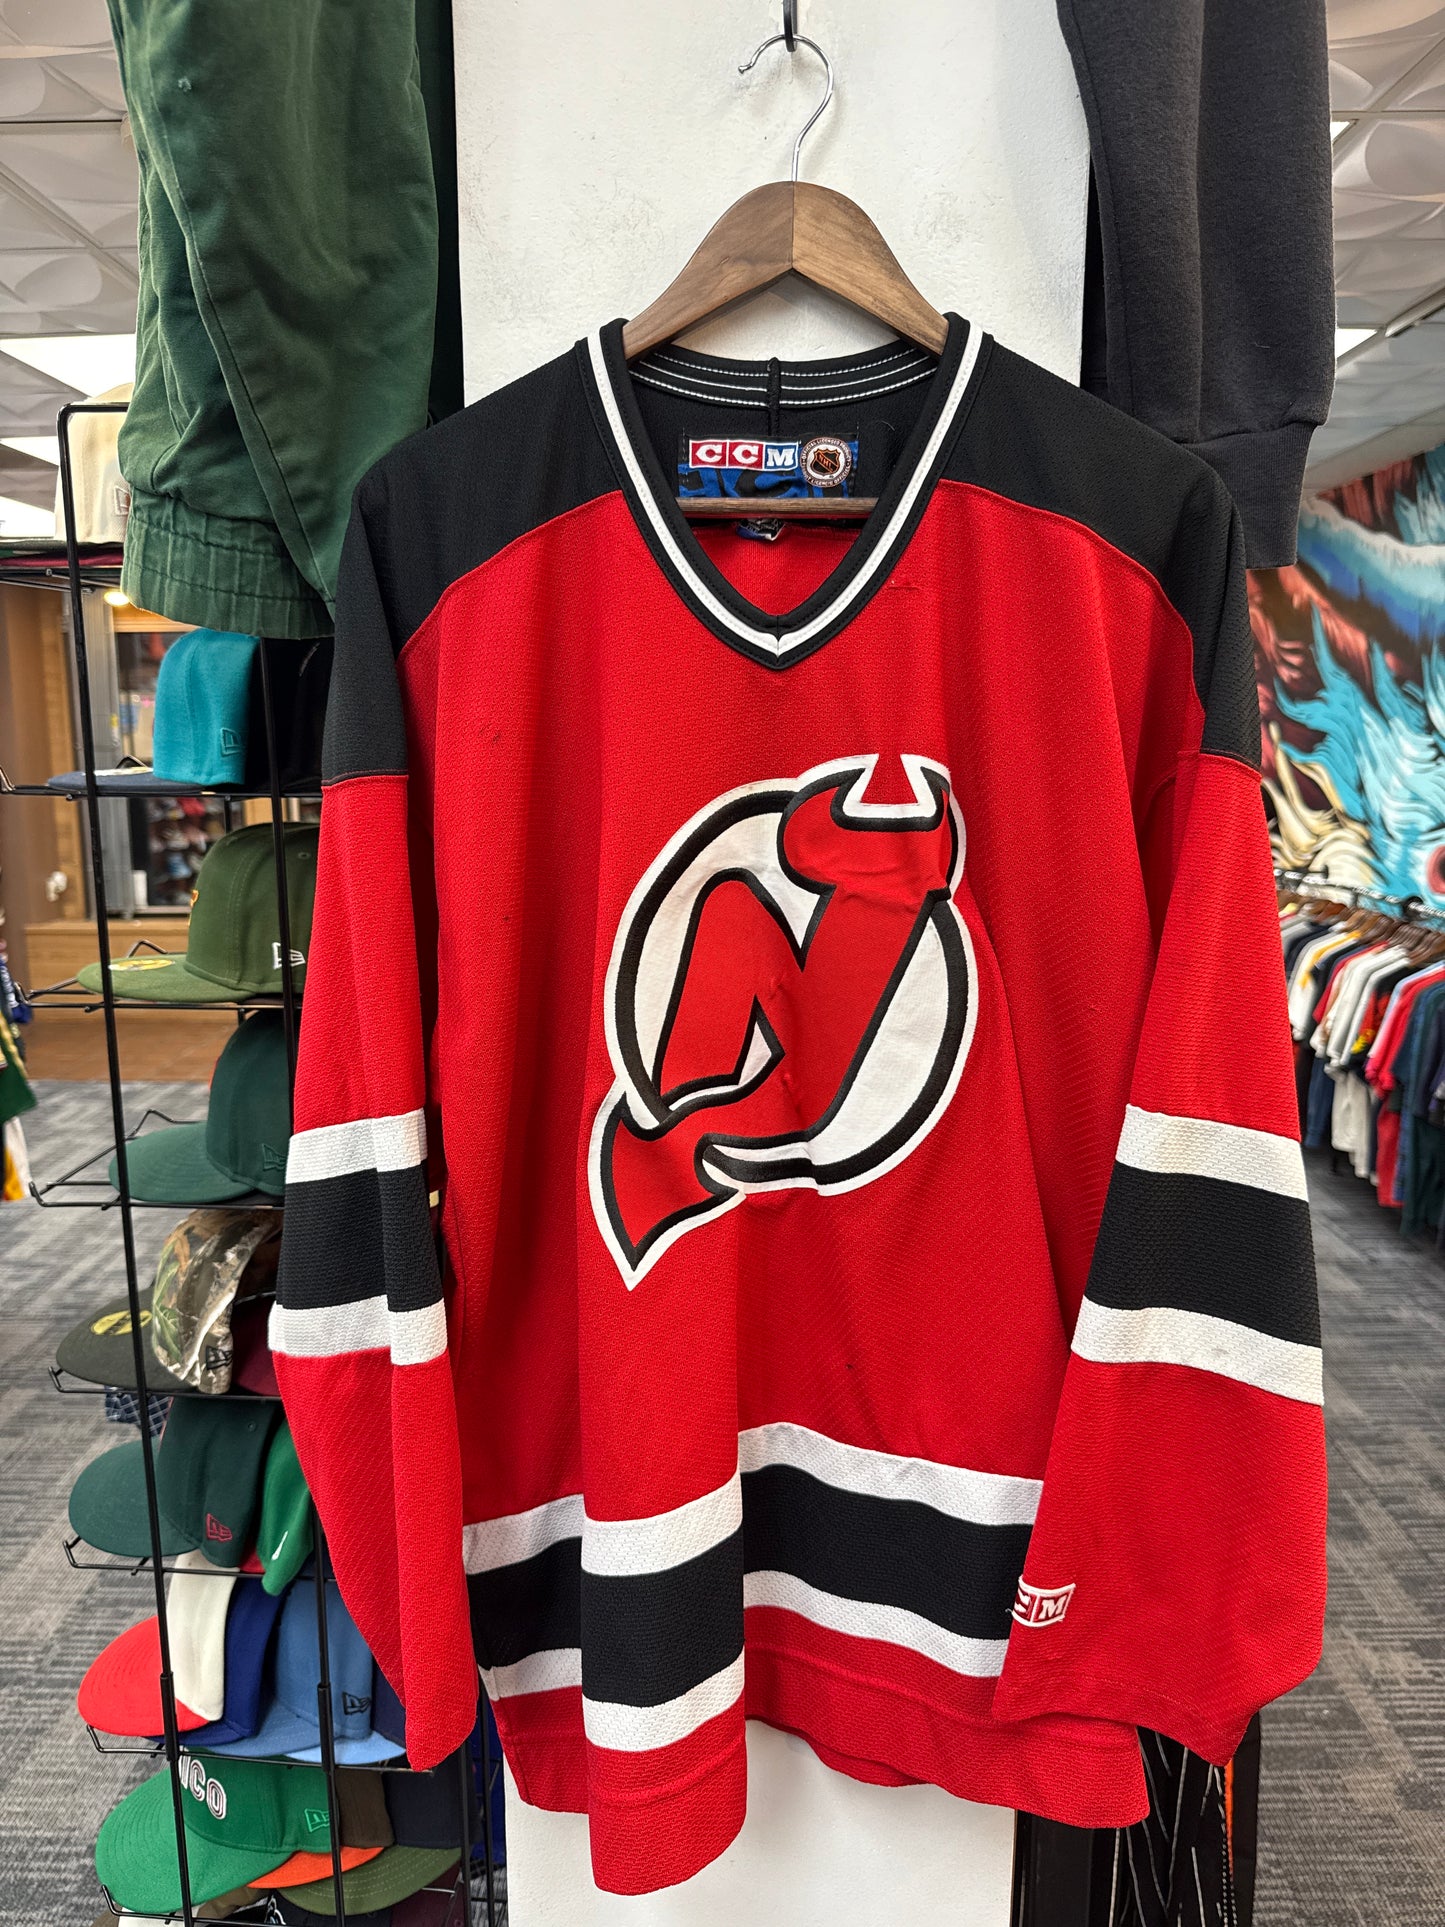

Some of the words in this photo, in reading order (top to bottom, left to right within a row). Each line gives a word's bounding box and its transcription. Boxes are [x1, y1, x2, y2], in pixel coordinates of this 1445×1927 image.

[694, 443, 796, 468] CCM
[818, 454, 834, 471] NHL
[178, 1745, 227, 1820] ICO
